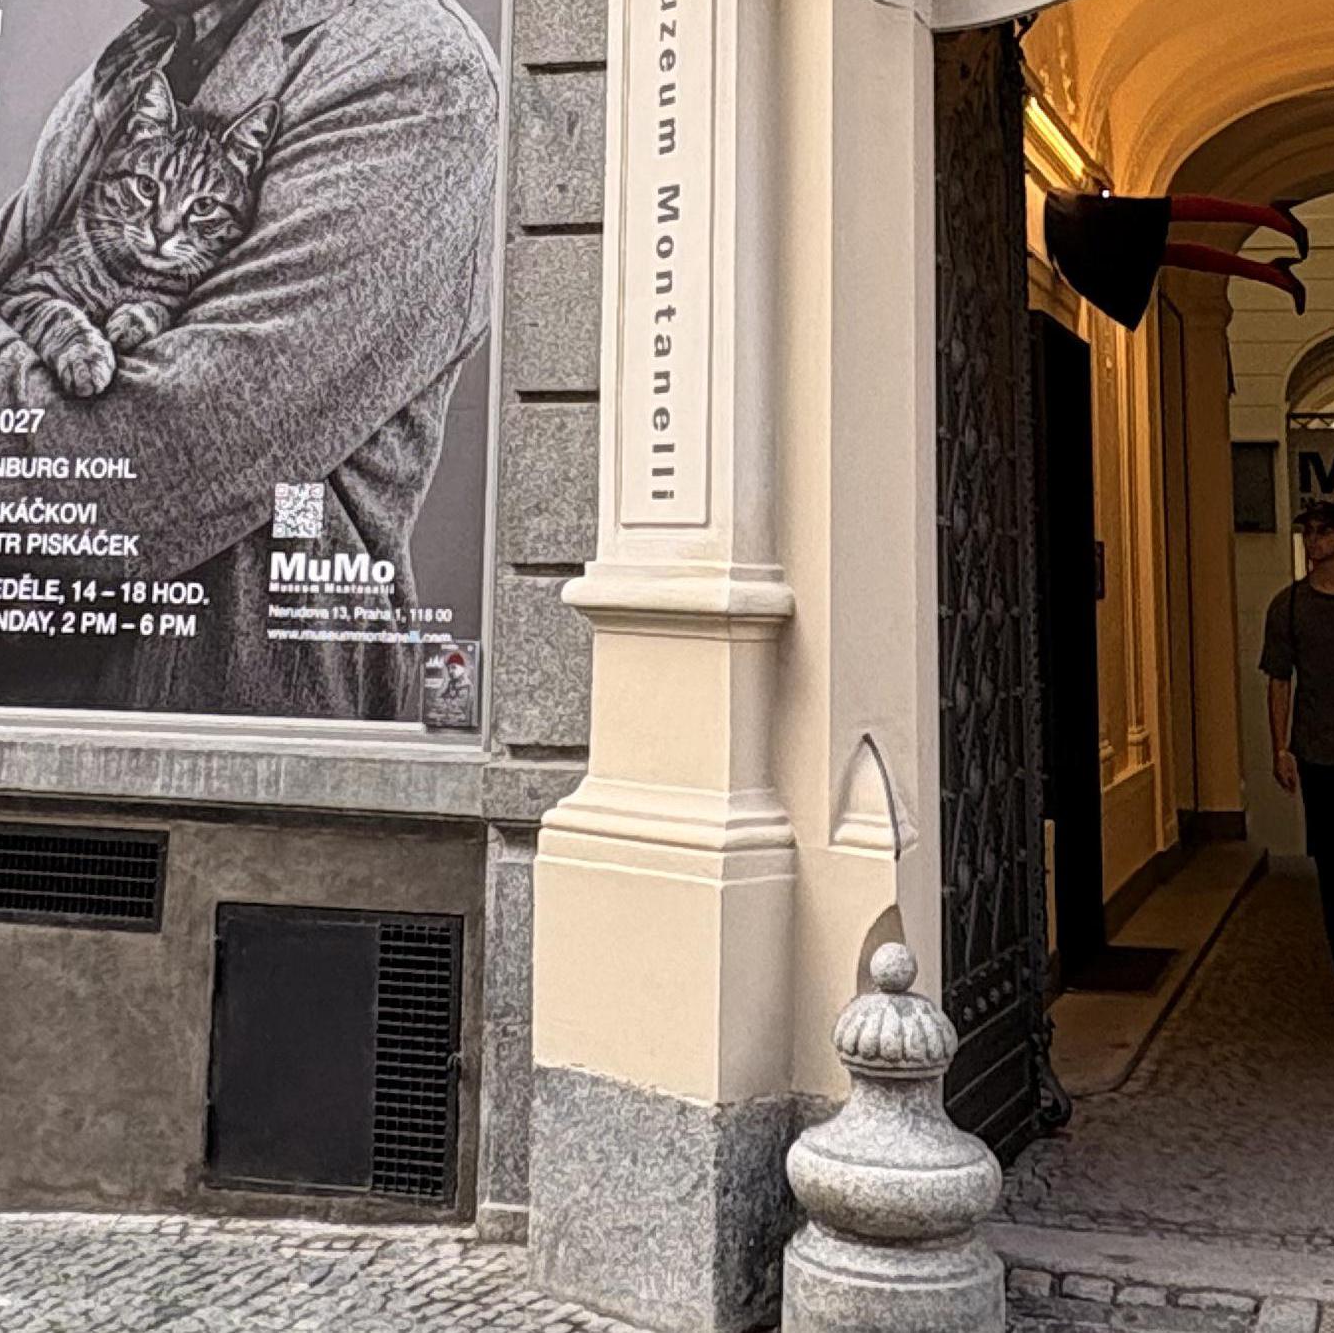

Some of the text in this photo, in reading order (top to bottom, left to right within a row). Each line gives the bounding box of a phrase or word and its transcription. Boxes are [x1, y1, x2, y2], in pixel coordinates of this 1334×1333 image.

[650, 183, 681, 501] Montanelli
[74, 457, 137, 479] KOHL
[26, 528, 140, 557] PISKÁČEK
[270, 551, 396, 584] MuMo
[71, 580, 97, 603] 14
[120, 581, 147, 604] 18
[151, 582, 210, 606] HOD.
[61, 612, 76, 634] 2
[80, 612, 117, 635] PM
[139, 614, 155, 636] 6
[159, 614, 197, 637] PM
